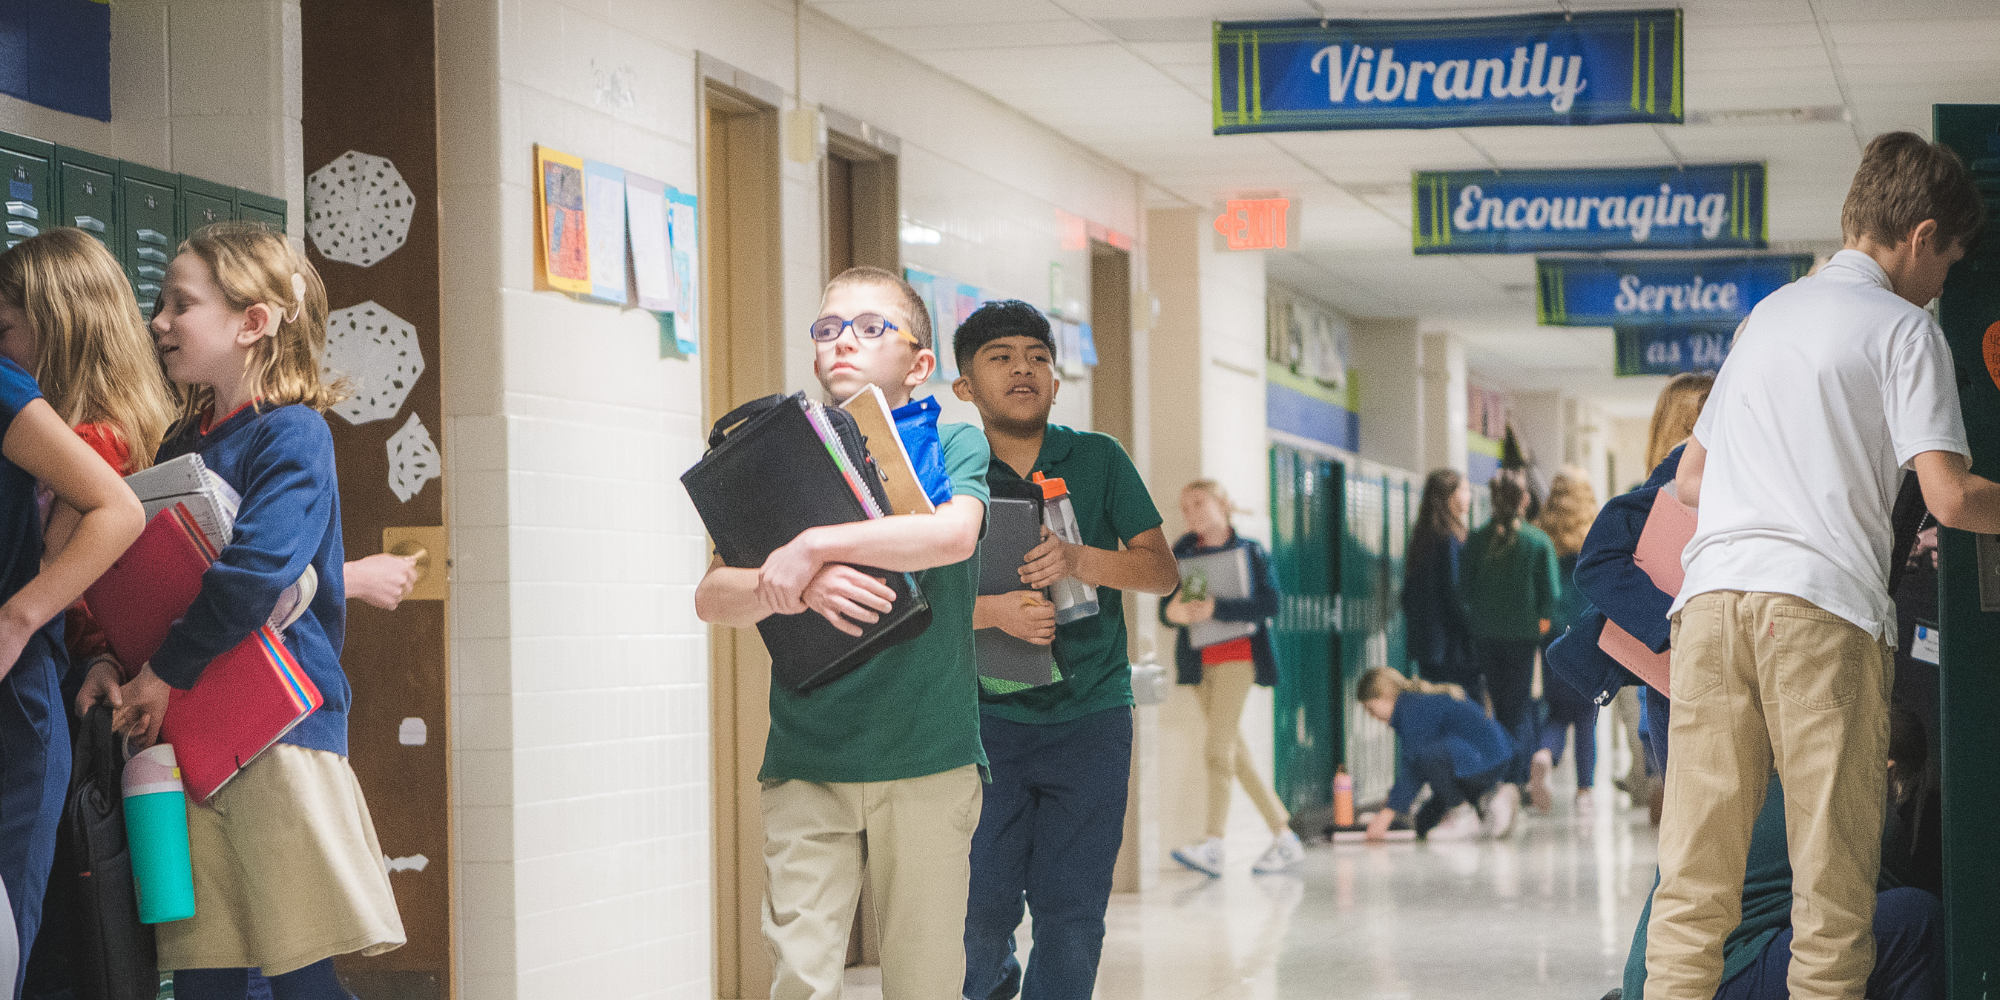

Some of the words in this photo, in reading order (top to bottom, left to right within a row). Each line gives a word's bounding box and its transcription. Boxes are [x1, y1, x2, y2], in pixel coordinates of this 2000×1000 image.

[1310, 42, 1587, 113] Vibrantly
[1227, 198, 1290, 250] EXIT
[1453, 183, 1729, 242] Encouraging
[1614, 274, 1738, 312] Service
